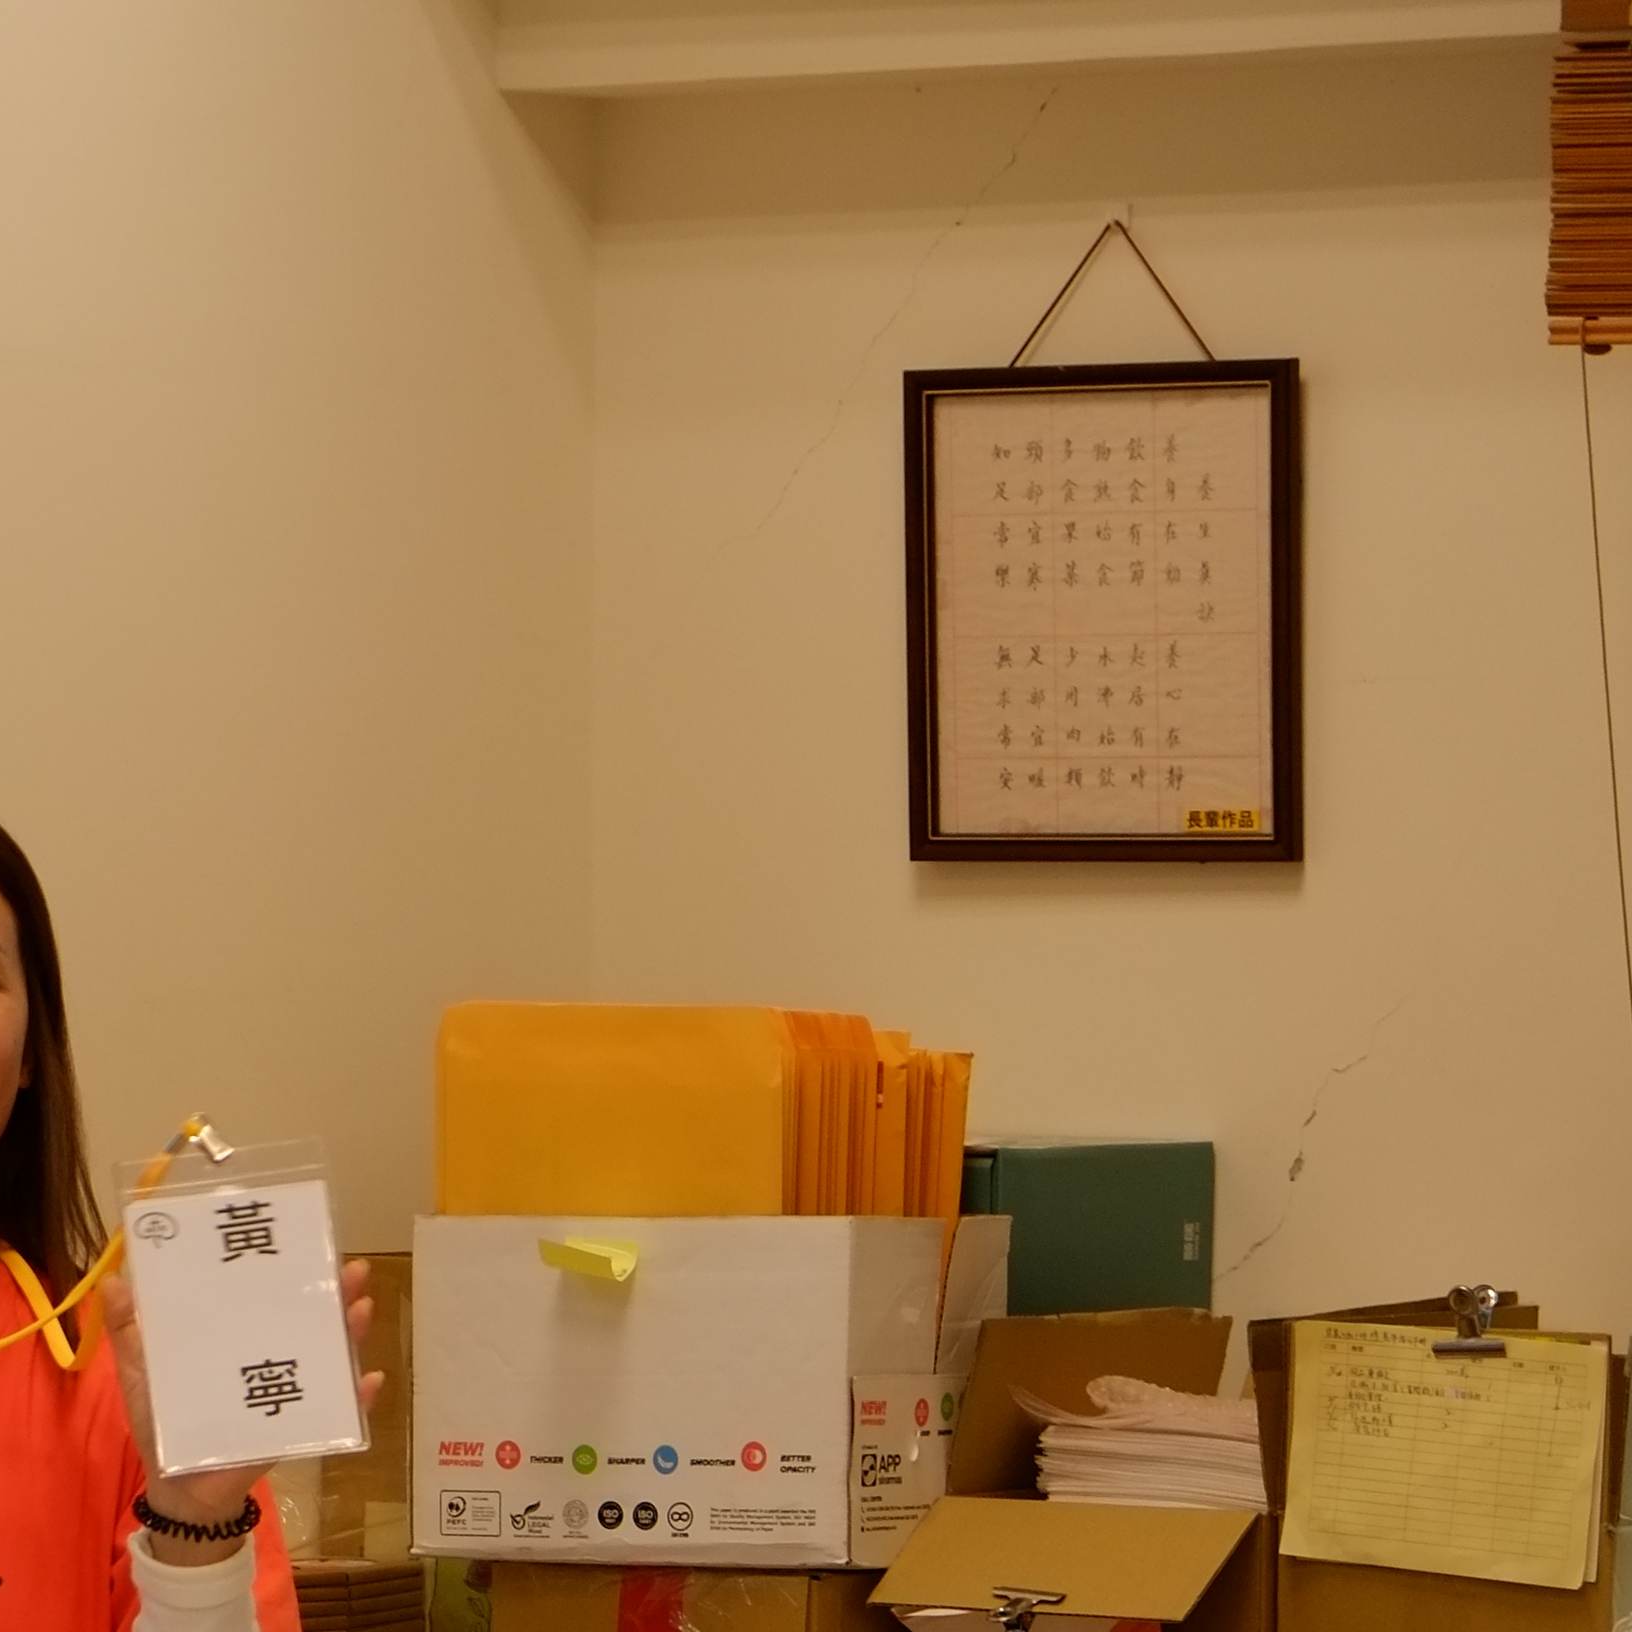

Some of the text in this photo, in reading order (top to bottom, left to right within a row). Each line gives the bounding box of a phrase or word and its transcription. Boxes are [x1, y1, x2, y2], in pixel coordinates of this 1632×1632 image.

[1186, 810, 1255, 830] 長輩作品
[438, 1440, 485, 1456] NEW!
[780, 1454, 812, 1463] BETTER
[878, 1454, 902, 1473] APP
